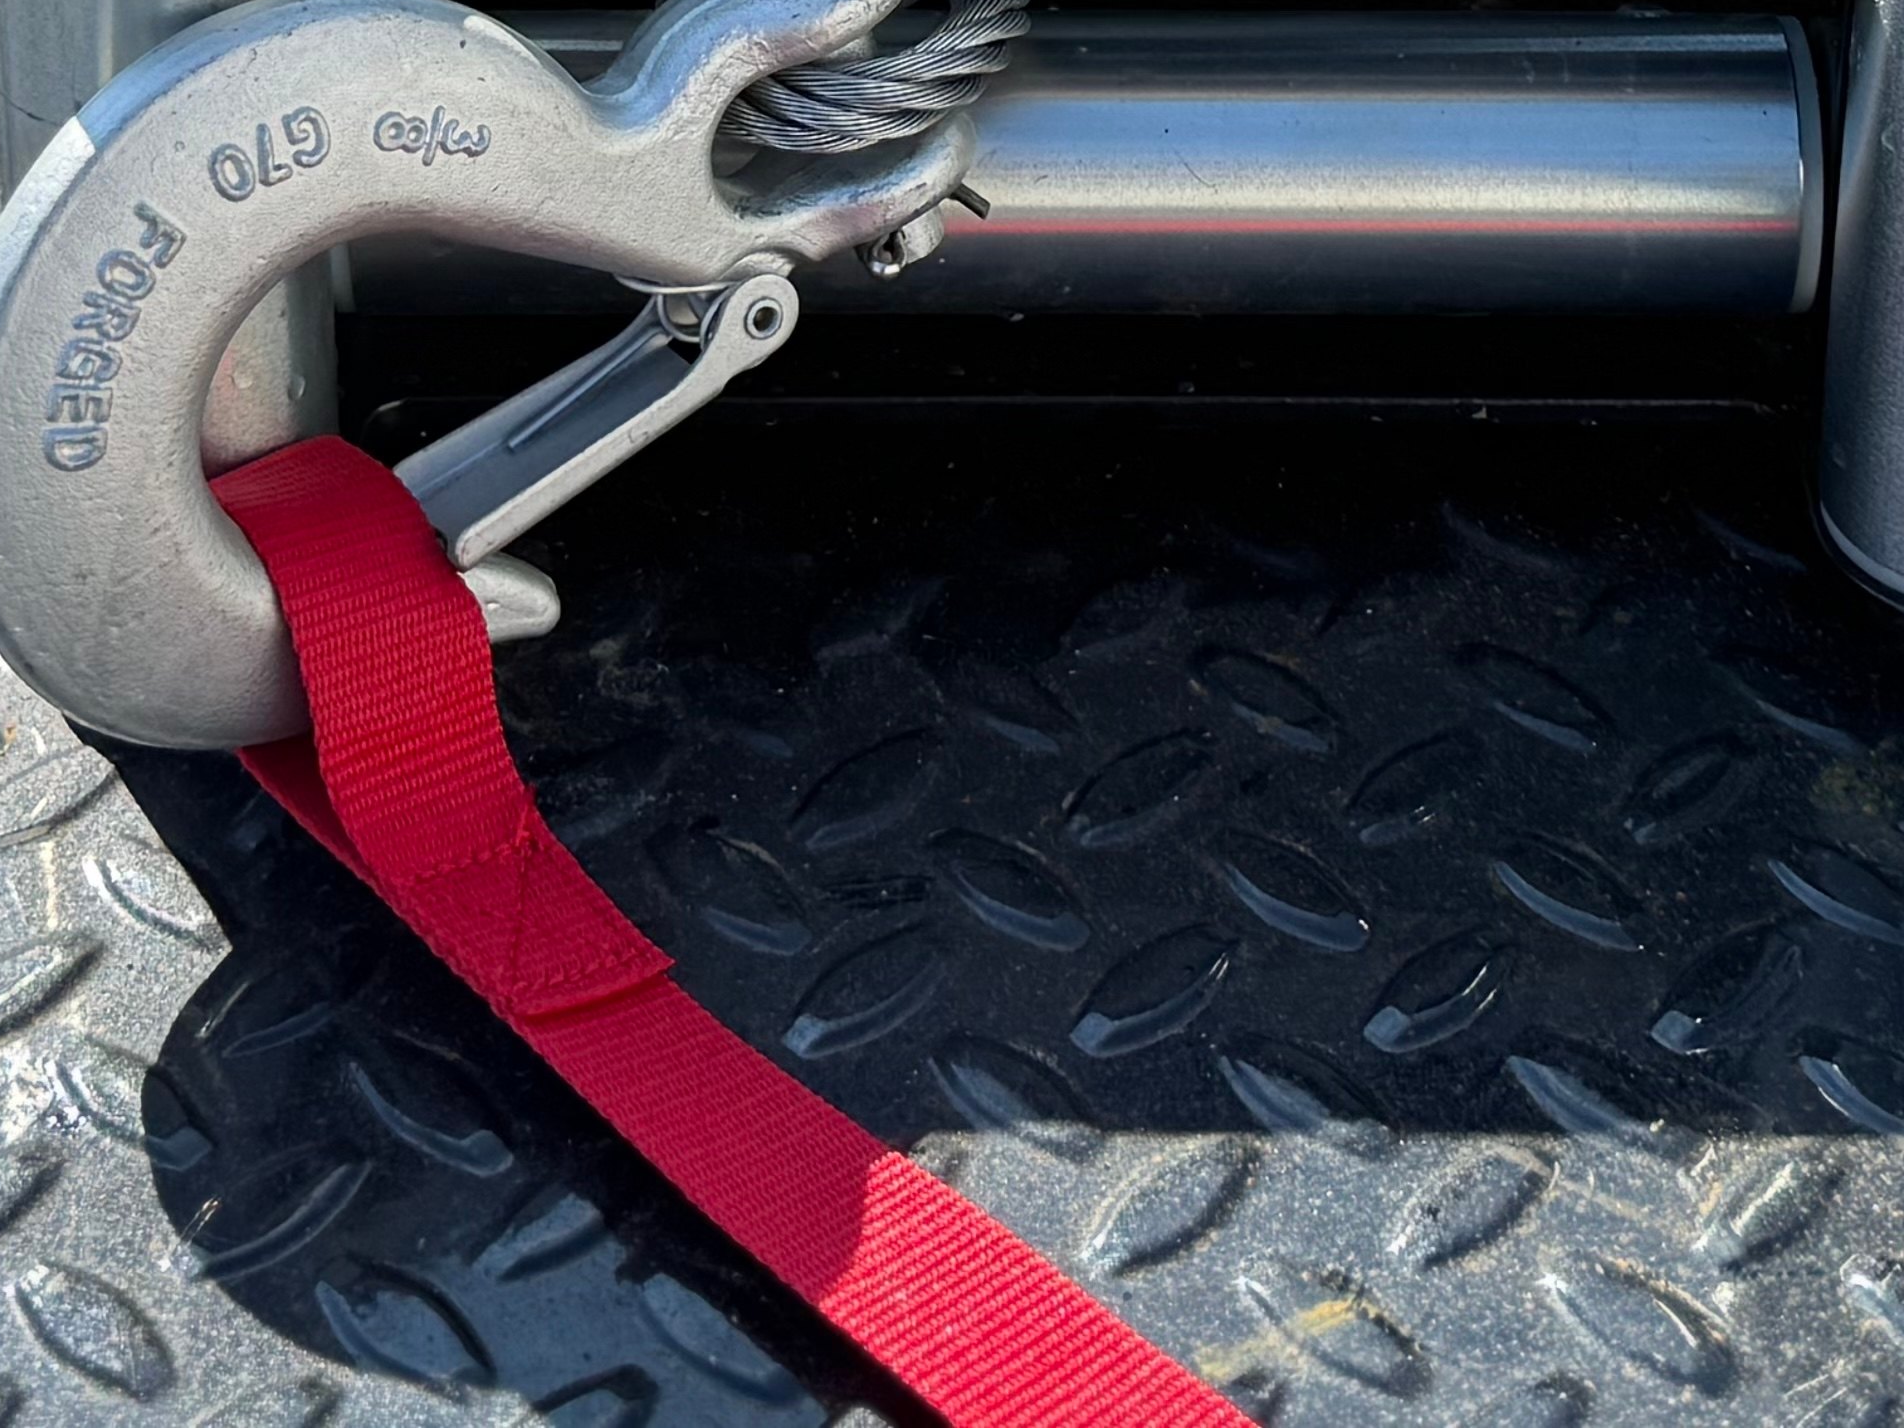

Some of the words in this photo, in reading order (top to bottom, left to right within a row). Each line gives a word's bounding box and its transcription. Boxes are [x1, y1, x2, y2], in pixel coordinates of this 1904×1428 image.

[207, 105, 332, 203] G70
[373, 104, 492, 167] 3/8
[41, 199, 189, 472] FORGED
